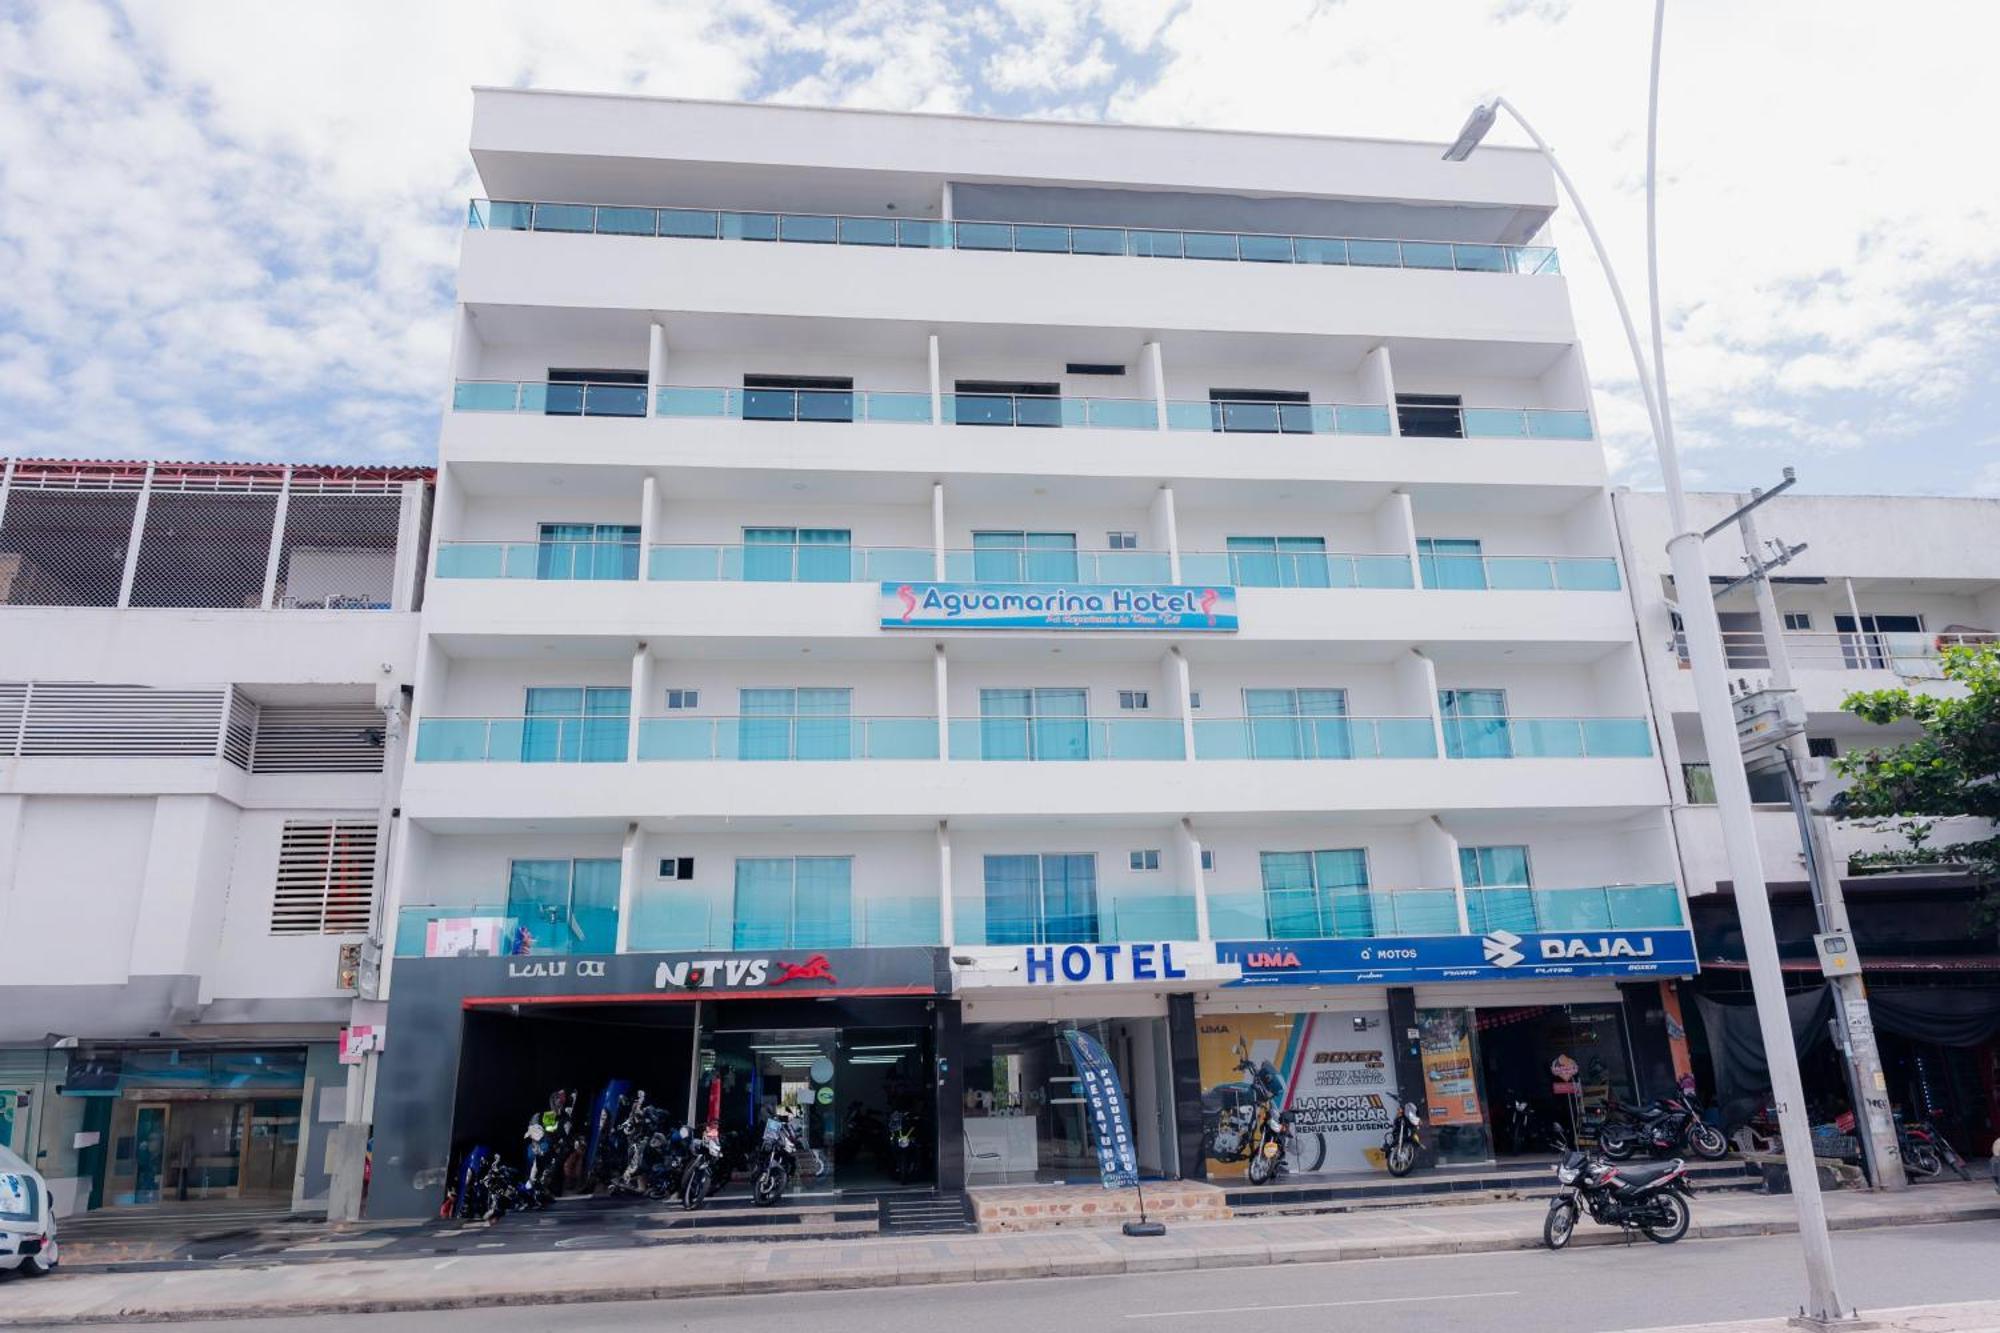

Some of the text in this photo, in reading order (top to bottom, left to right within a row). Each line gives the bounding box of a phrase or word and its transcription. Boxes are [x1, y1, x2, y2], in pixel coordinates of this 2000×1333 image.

[922, 589, 1196, 617] Aguamarina Hotel
[1248, 952, 1301, 967] UMA
[1377, 948, 1417, 960] MOTOS
[1026, 943, 1186, 983] HOTEL
[1314, 1051, 1382, 1063] BOXER
[1318, 1095, 1370, 1109] PROPIA
[1317, 1107, 1387, 1122] AHORRAR
[1296, 1123, 1340, 1134] RENUEVA
[1341, 1123, 1354, 1131] SU
